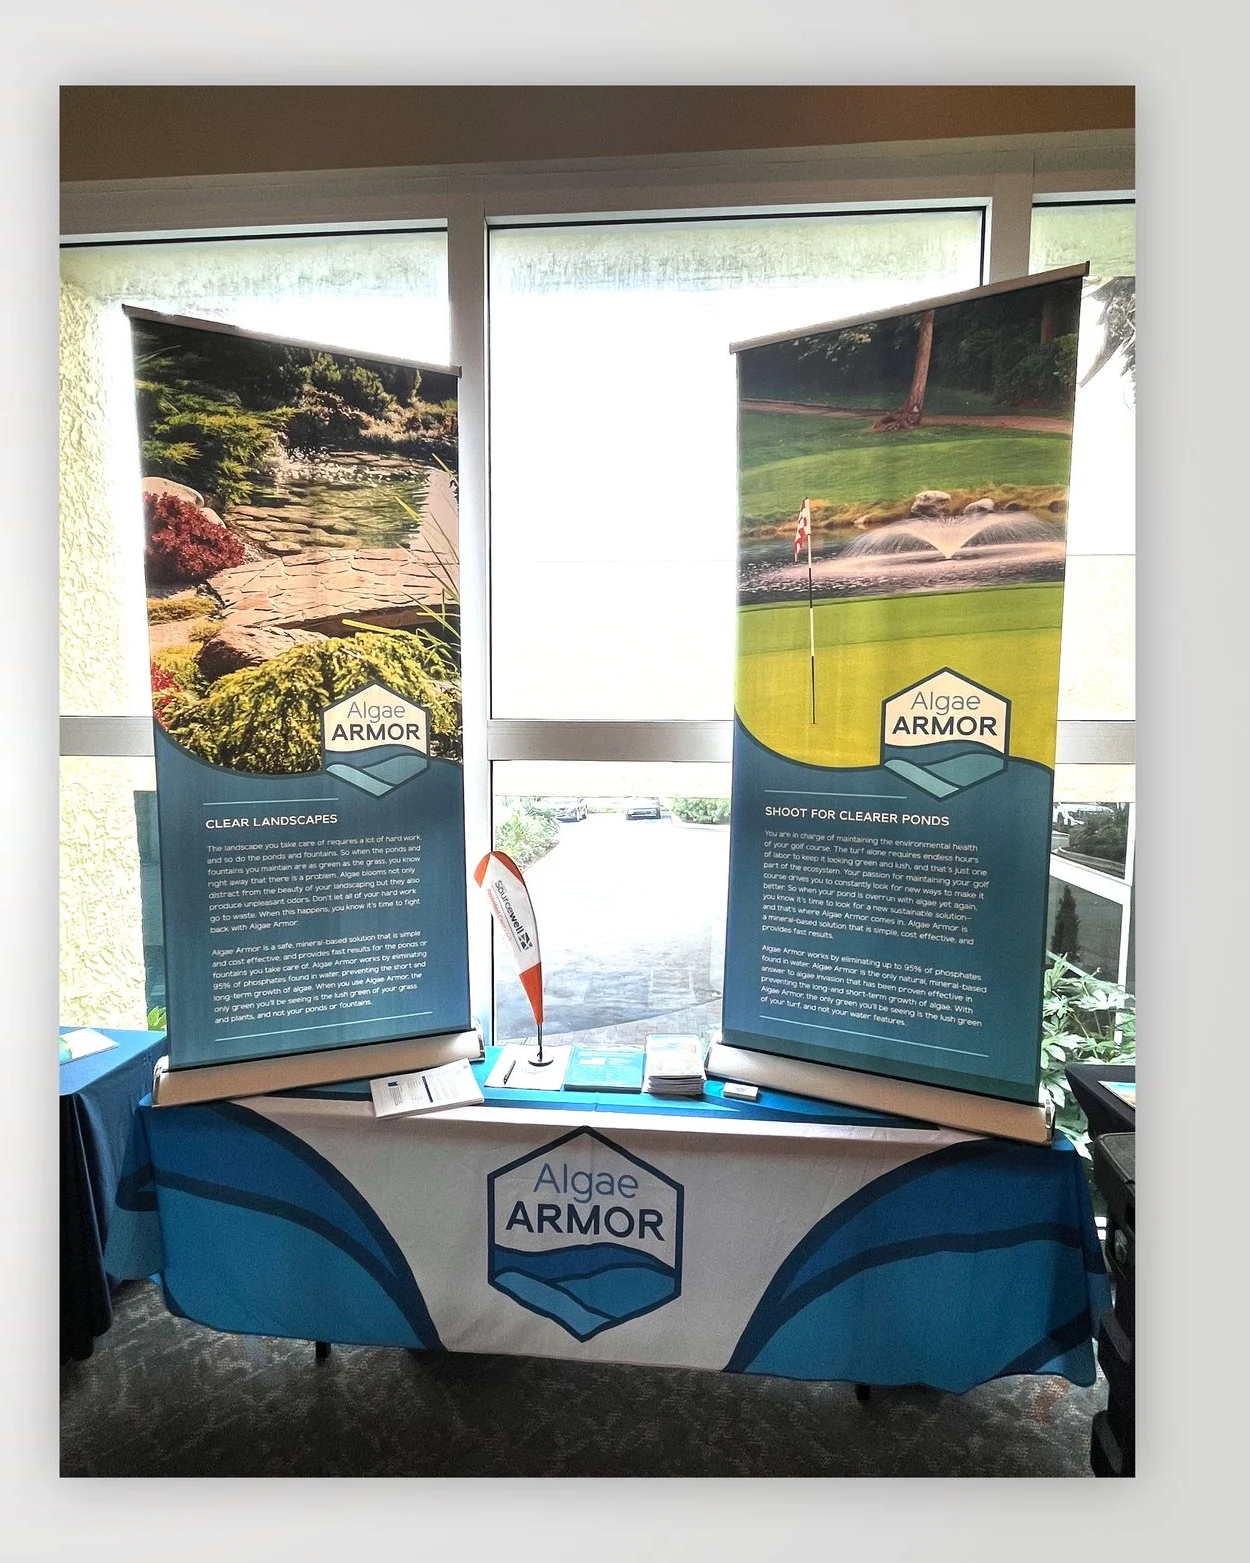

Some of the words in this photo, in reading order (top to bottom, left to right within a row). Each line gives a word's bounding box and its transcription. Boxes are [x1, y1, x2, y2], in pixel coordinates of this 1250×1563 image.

[347, 701, 405, 723] Algae
[910, 691, 981, 716] Algae
[331, 723, 420, 741] ARMOR
[891, 715, 998, 737] ARMOR
[205, 817, 250, 829] CLEAR
[253, 813, 338, 827] LANDSCAPES
[765, 805, 807, 818] SHOOT
[811, 808, 836, 820] FOR
[839, 809, 898, 823] CLEARER
[901, 813, 950, 826] PONDS
[207, 844, 223, 852] The
[224, 843, 263, 851] landscape
[264, 842, 279, 850] you
[280, 840, 297, 848] take
[316, 838, 325, 846] of
[326, 838, 358, 846] requires
[375, 835, 384, 843] of
[764, 829, 778, 837] You
[799, 832, 825, 842] charge
[826, 833, 835, 841] of
[836, 835, 879, 846] maintaining
[879, 837, 893, 845] the
[894, 839, 951, 850] environmental
[952, 842, 978, 851] health
[763, 861, 779, 869] part
[789, 863, 802, 871] the
[843, 868, 861, 876] Your
[862, 870, 891, 879] passion
[891, 872, 904, 880] for
[905, 874, 951, 886] maintaining
[951, 879, 971, 887] your
[972, 880, 989, 889] golf
[495, 880, 524, 934] Sourcewell
[761, 924, 792, 933] provides
[793, 926, 807, 936] fast
[211, 959, 227, 968] and
[228, 957, 245, 966] cost
[282, 952, 297, 961] and
[298, 950, 330, 960] provides
[331, 947, 346, 955] fast
[346, 945, 371, 953] results
[371, 943, 383, 951] for
[397, 940, 419, 949] ponds
[213, 981, 231, 990] 95%
[232, 980, 241, 988] of
[243, 976, 287, 988] phosphates
[287, 973, 310, 982] found
[341, 966, 379, 977] preventing
[380, 964, 392, 972] the
[393, 962, 412, 970] short
[413, 960, 426, 968] and
[760, 975, 798, 988] preventing
[798, 980, 811, 989] the
[845, 988, 887, 1001] short-term
[888, 995, 917, 1005] growth
[918, 999, 927, 1007] of
[954, 1004, 973, 1014] With
[533, 1162, 639, 1204] Algae
[505, 1200, 665, 1241] ARMOR
